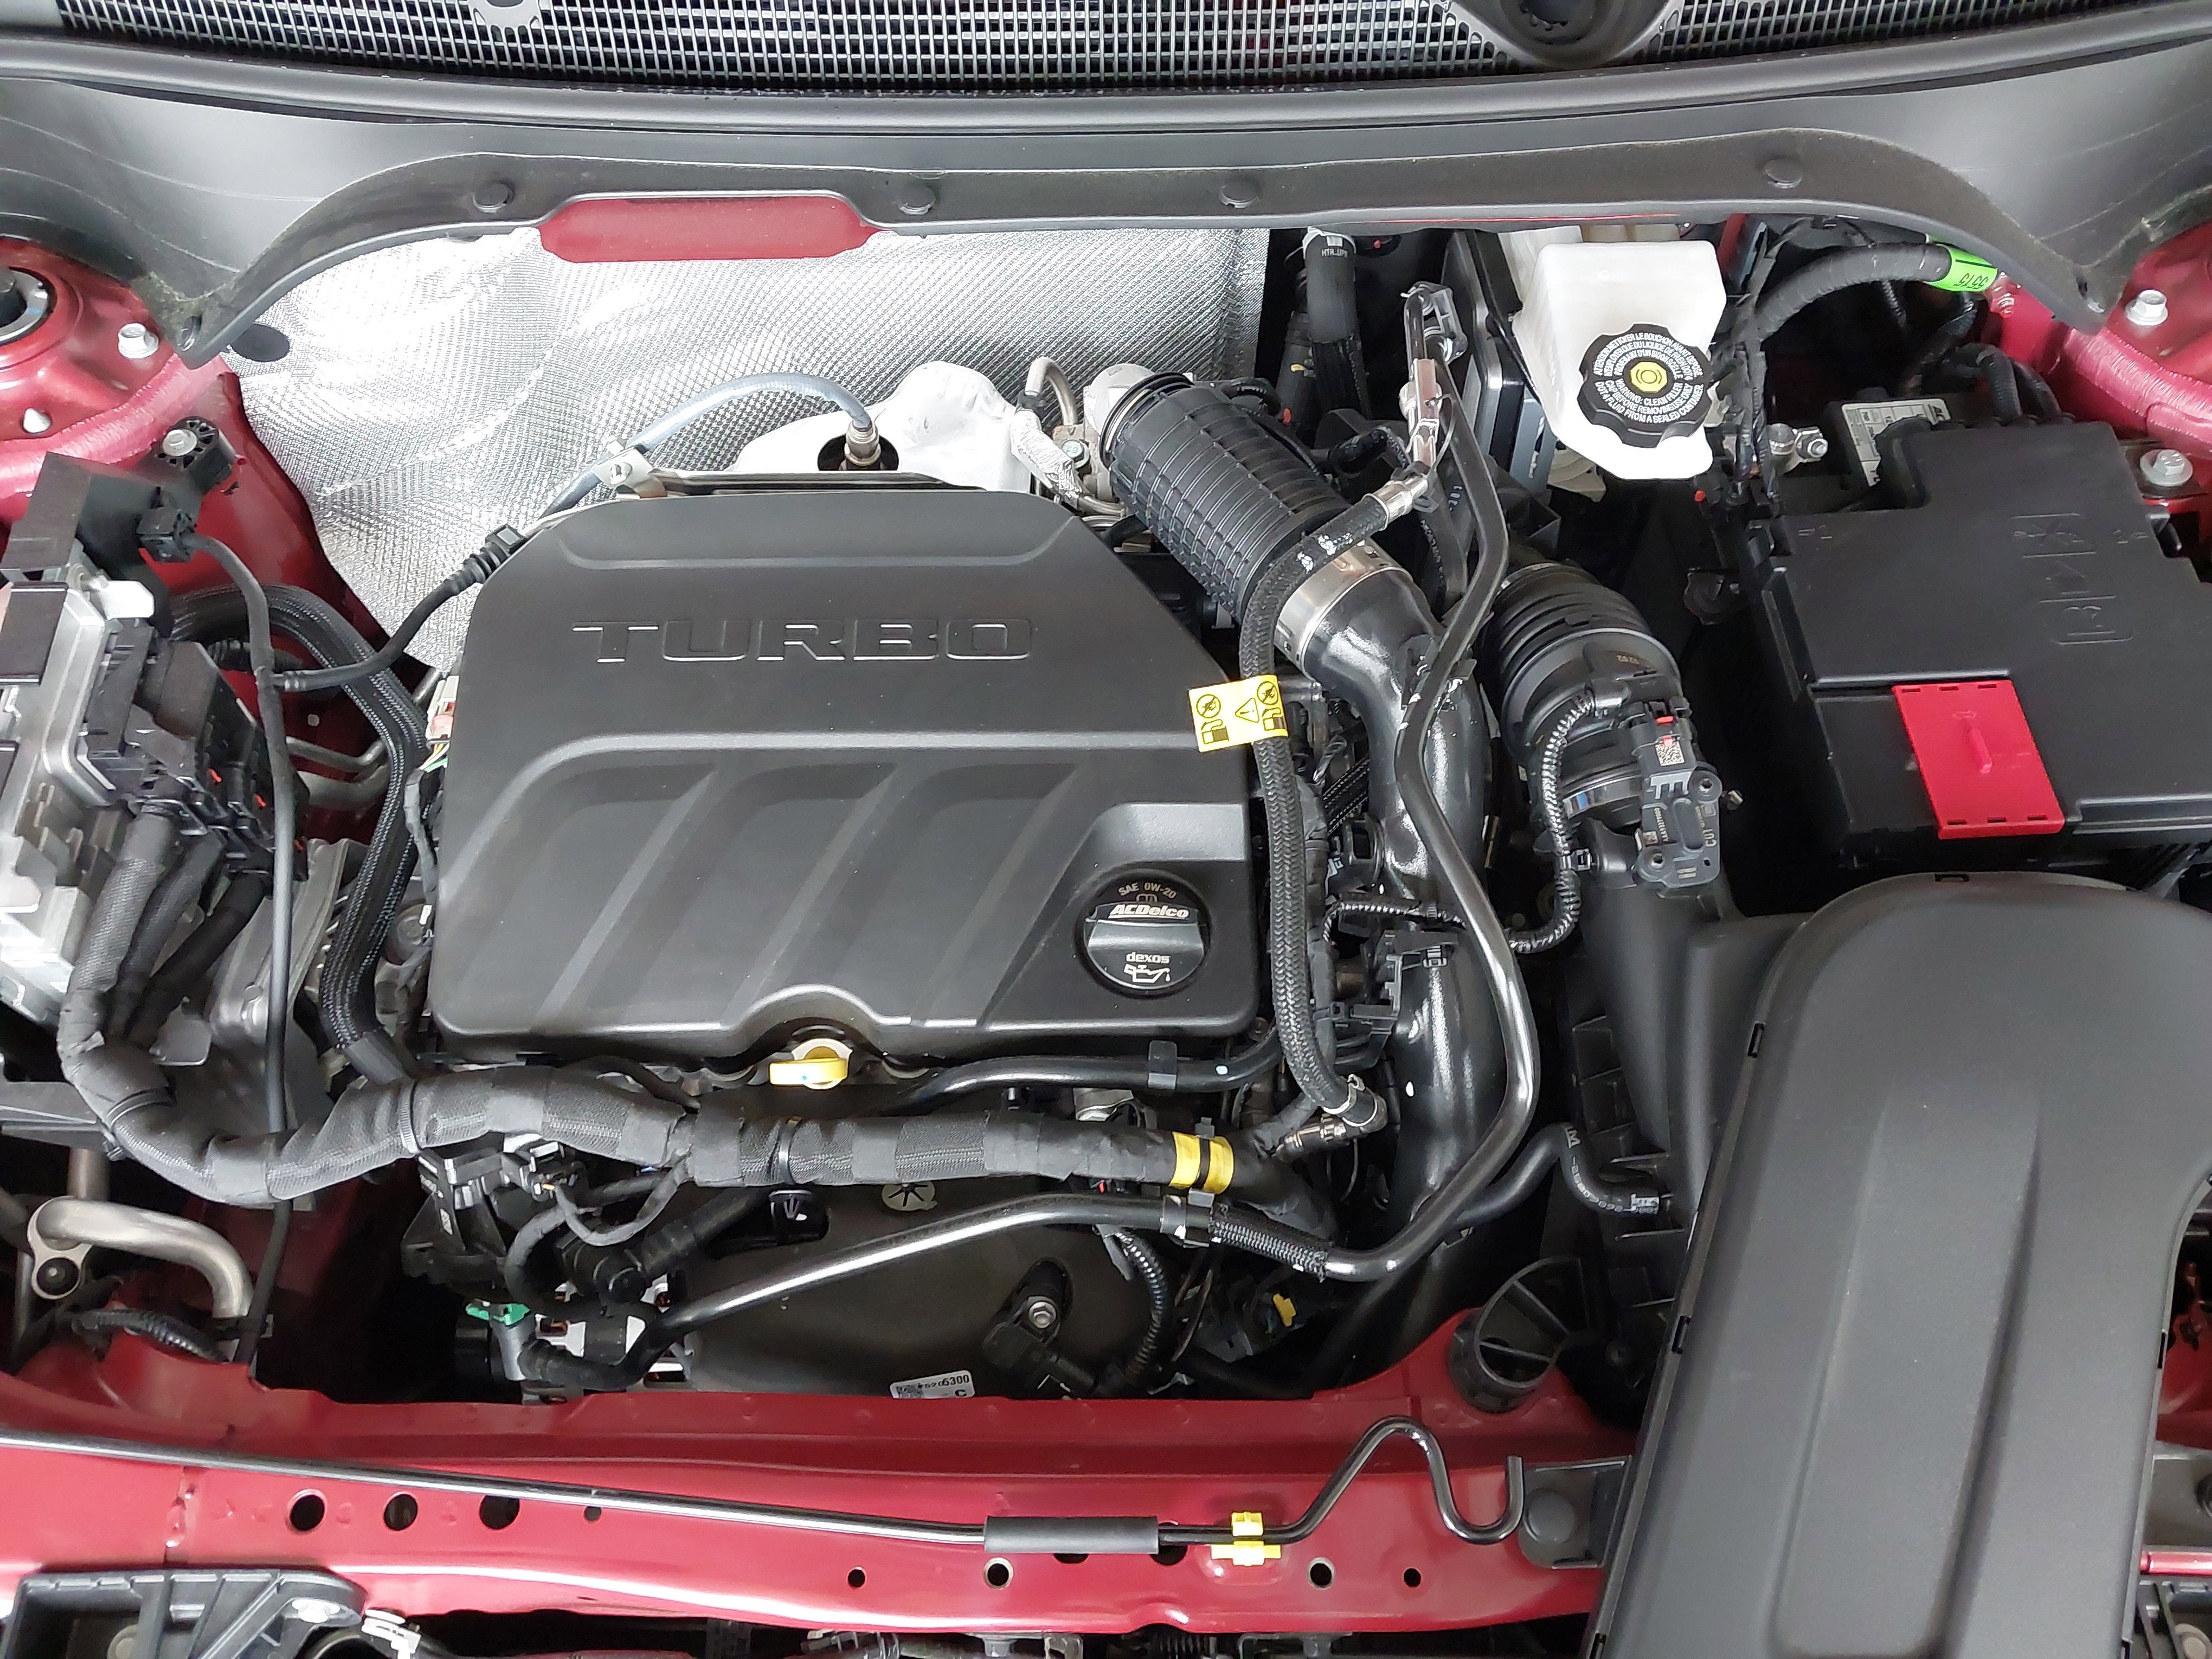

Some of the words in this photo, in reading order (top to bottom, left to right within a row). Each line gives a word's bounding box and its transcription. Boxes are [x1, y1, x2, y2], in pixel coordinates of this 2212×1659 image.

[1633, 341, 1642, 350] DU
[1642, 341, 1666, 352] LIQUIDE
[1664, 346, 1675, 356] DE
[1644, 332, 1674, 346] BOUCHON
[1671, 342, 1692, 357] AVANT
[1651, 350, 1669, 363] BIDON
[1605, 380, 1618, 393] CAP
[1612, 391, 1638, 411] BEFORE
[1681, 383, 1693, 399] ONLY
[1615, 378, 1643, 404] WARNING:
[1643, 397, 1668, 406] CLEAN
[1666, 382, 1683, 401] FILLER
[1605, 397, 1625, 414] FLUID
[1624, 409, 1646, 422] FROM
[1652, 411, 1681, 423] SEALED
[1678, 384, 1703, 416] CONTAINER
[573, 619, 1031, 661] TURBO
[1118, 882, 1139, 896] SAE
[1144, 882, 1176, 898] 0W-20
[1110, 904, 1189, 917] ACDelco
[1126, 951, 1171, 963] dexos
